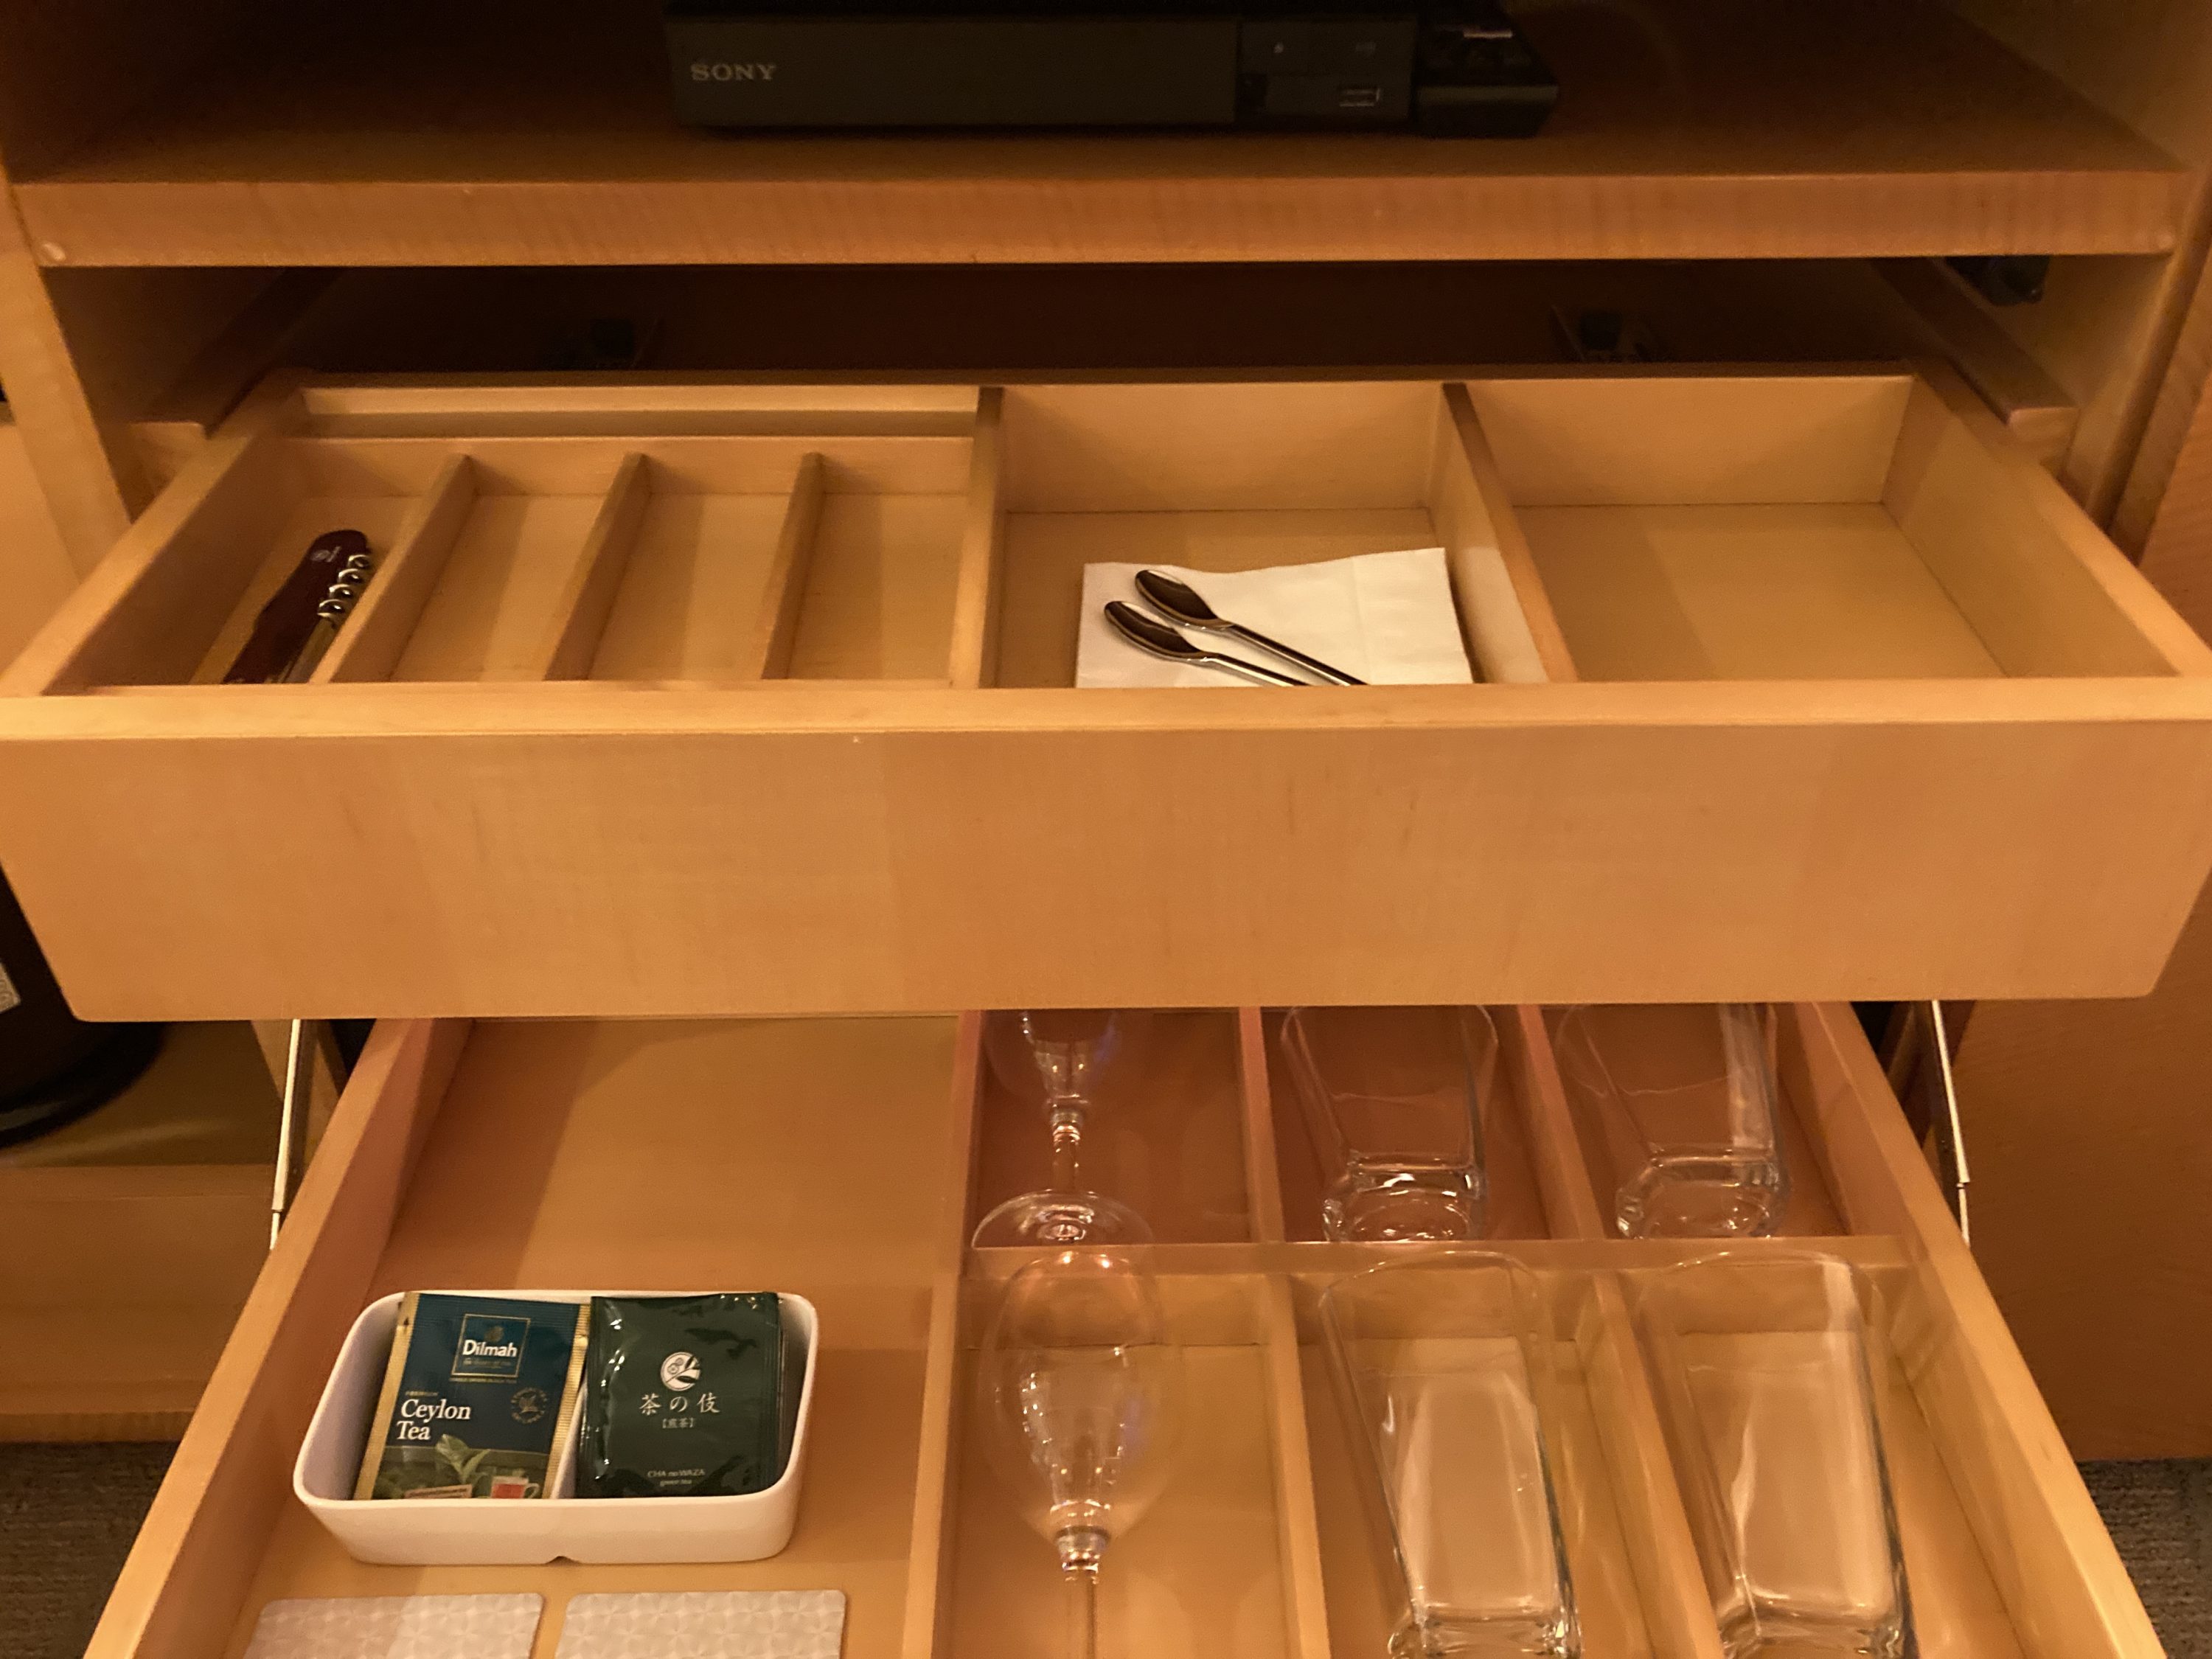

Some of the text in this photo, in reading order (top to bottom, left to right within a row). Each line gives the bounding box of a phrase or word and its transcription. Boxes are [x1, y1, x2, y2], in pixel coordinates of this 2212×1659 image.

[690, 63, 777, 81] SONY
[462, 1339, 518, 1357] Dilmah
[400, 1398, 472, 1423] Ceylon
[396, 1420, 431, 1440] Tea
